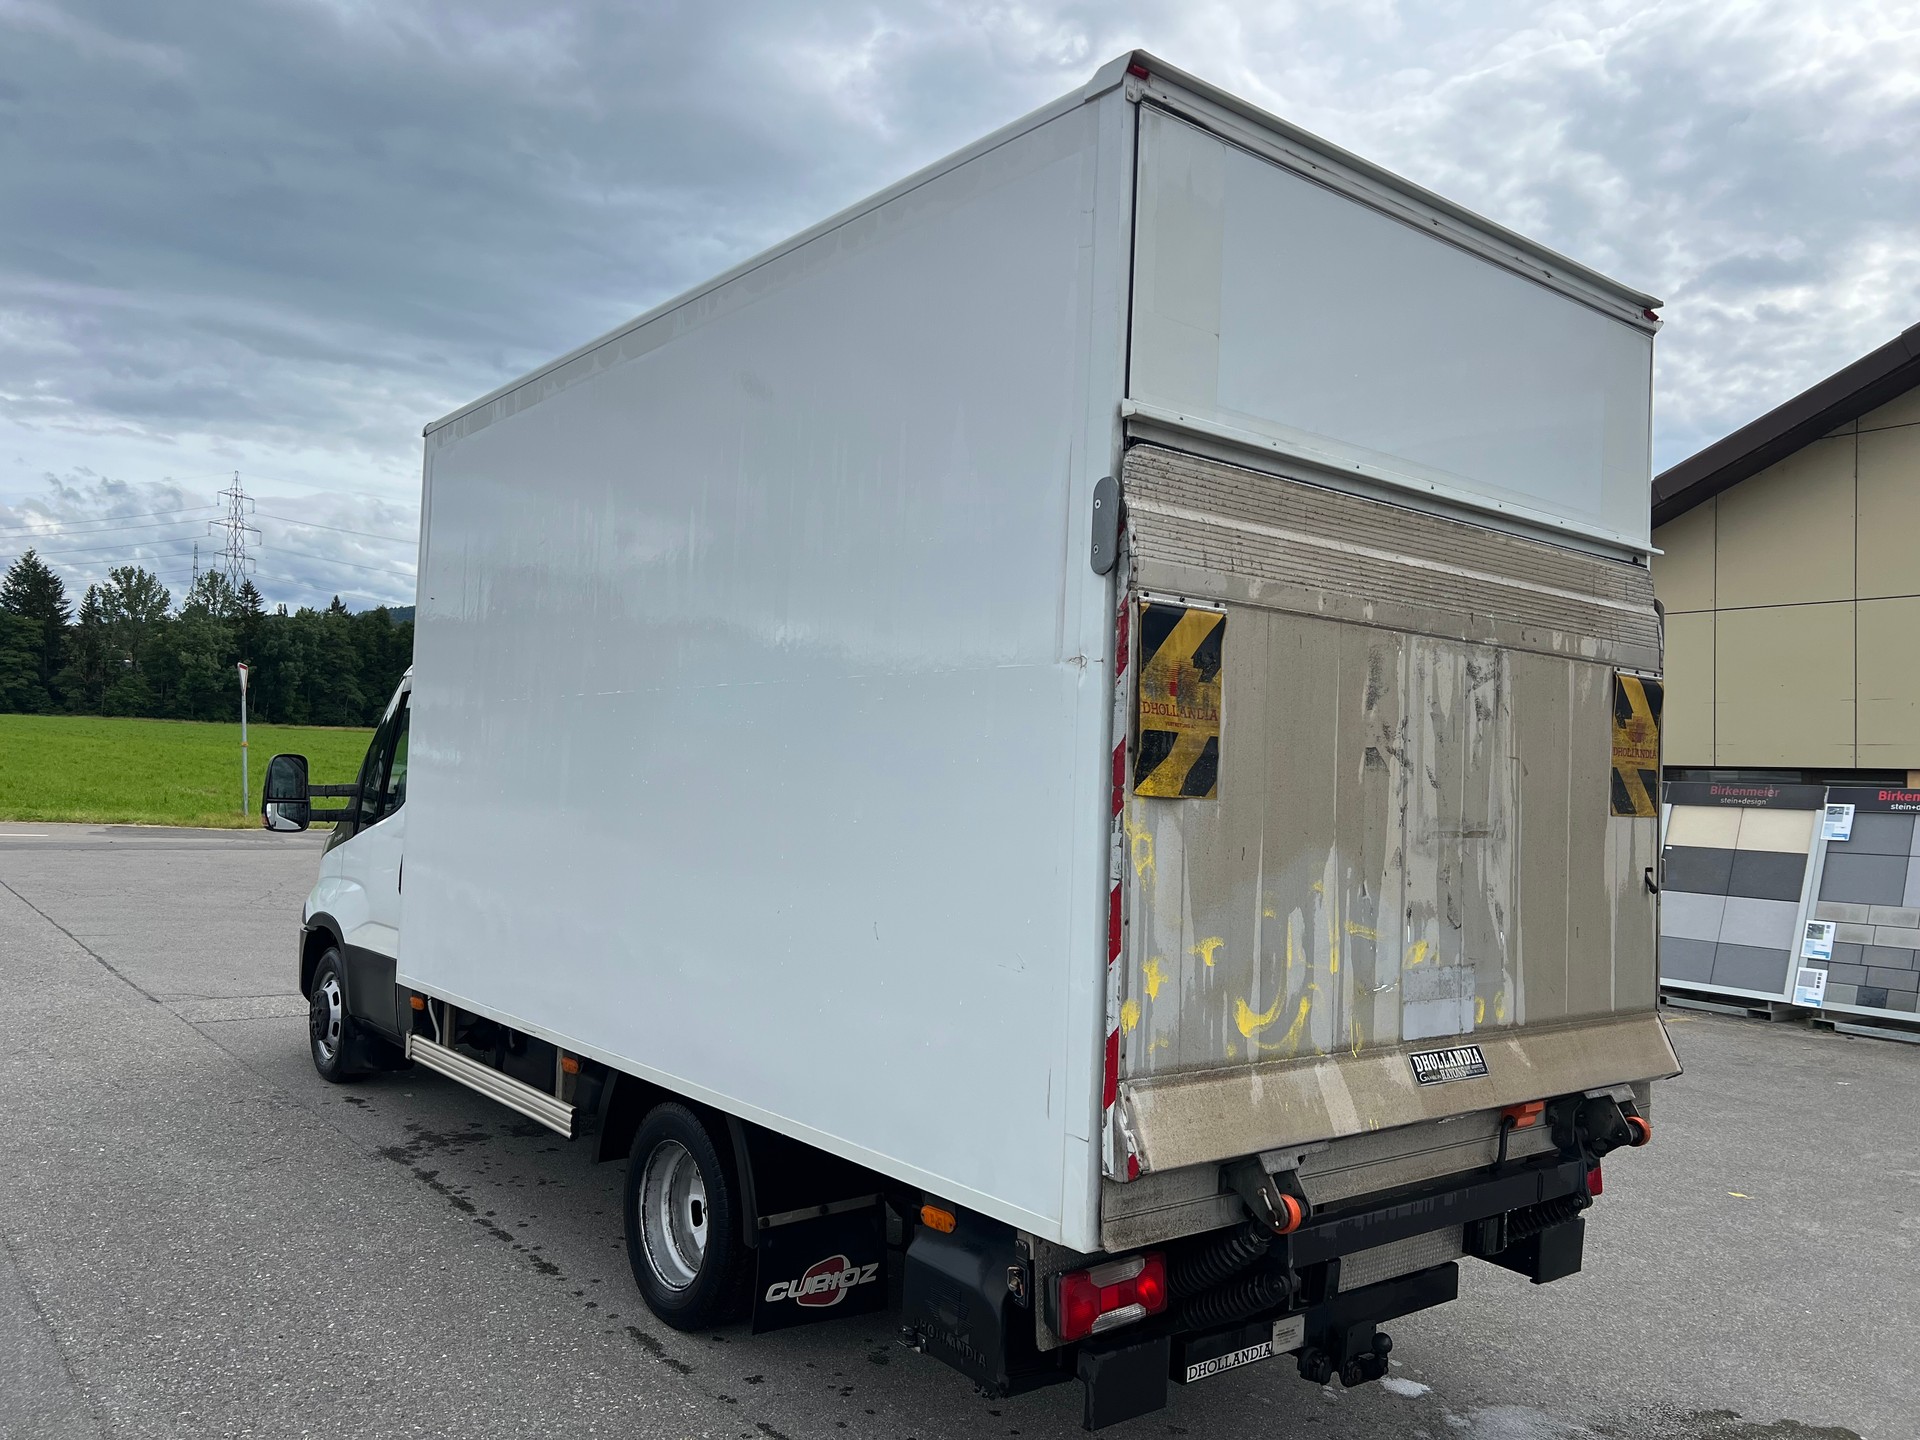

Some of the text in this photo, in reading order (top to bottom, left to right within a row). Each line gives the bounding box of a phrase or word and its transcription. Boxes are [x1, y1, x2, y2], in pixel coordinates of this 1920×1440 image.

[1613, 747, 1656, 759] DHOLLANDIA
[1710, 786, 1780, 797] Birkenmeier
[1412, 1048, 1482, 1072] DHOLLANDIA
[1188, 1342, 1272, 1381] DHOLLANDIA
